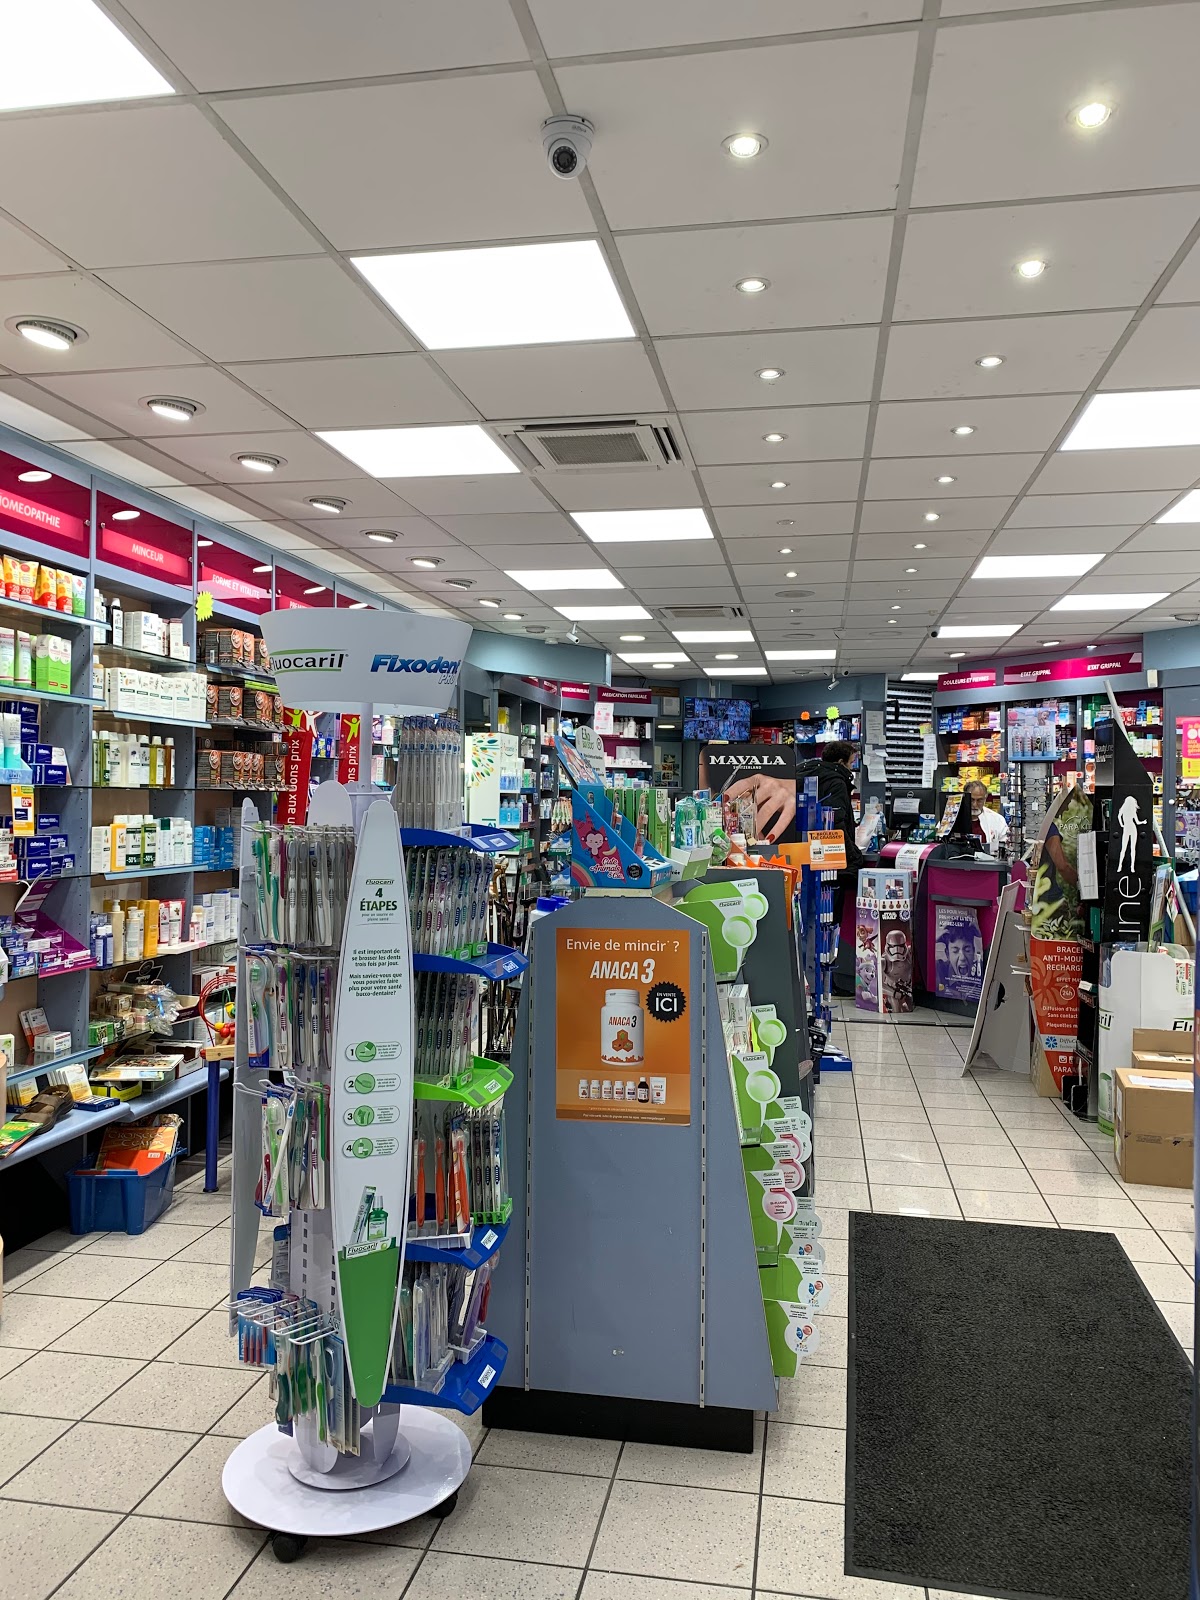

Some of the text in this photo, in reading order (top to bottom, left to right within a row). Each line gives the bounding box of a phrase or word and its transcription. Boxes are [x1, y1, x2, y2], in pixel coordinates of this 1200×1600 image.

[131, 543, 164, 564] MINCEUR
[212, 574, 231, 588] FORME
[231, 581, 239, 591] ET
[290, 739, 301, 761] prix
[347, 745, 359, 765] prix
[709, 755, 786, 765] MAVALA
[287, 794, 297, 814] aux
[375, 888, 383, 897] 4
[360, 898, 397, 911] ÉTAPES
[1111, 874, 1141, 942] ine
[566, 938, 600, 950] Envie
[604, 939, 620, 951] de
[673, 940, 680, 952] ?
[655, 997, 678, 1012] ICI
[1099, 1014, 1111, 1027] ril
[348, 1080, 354, 1088] 2
[347, 1242, 378, 1254] Fluocaril
